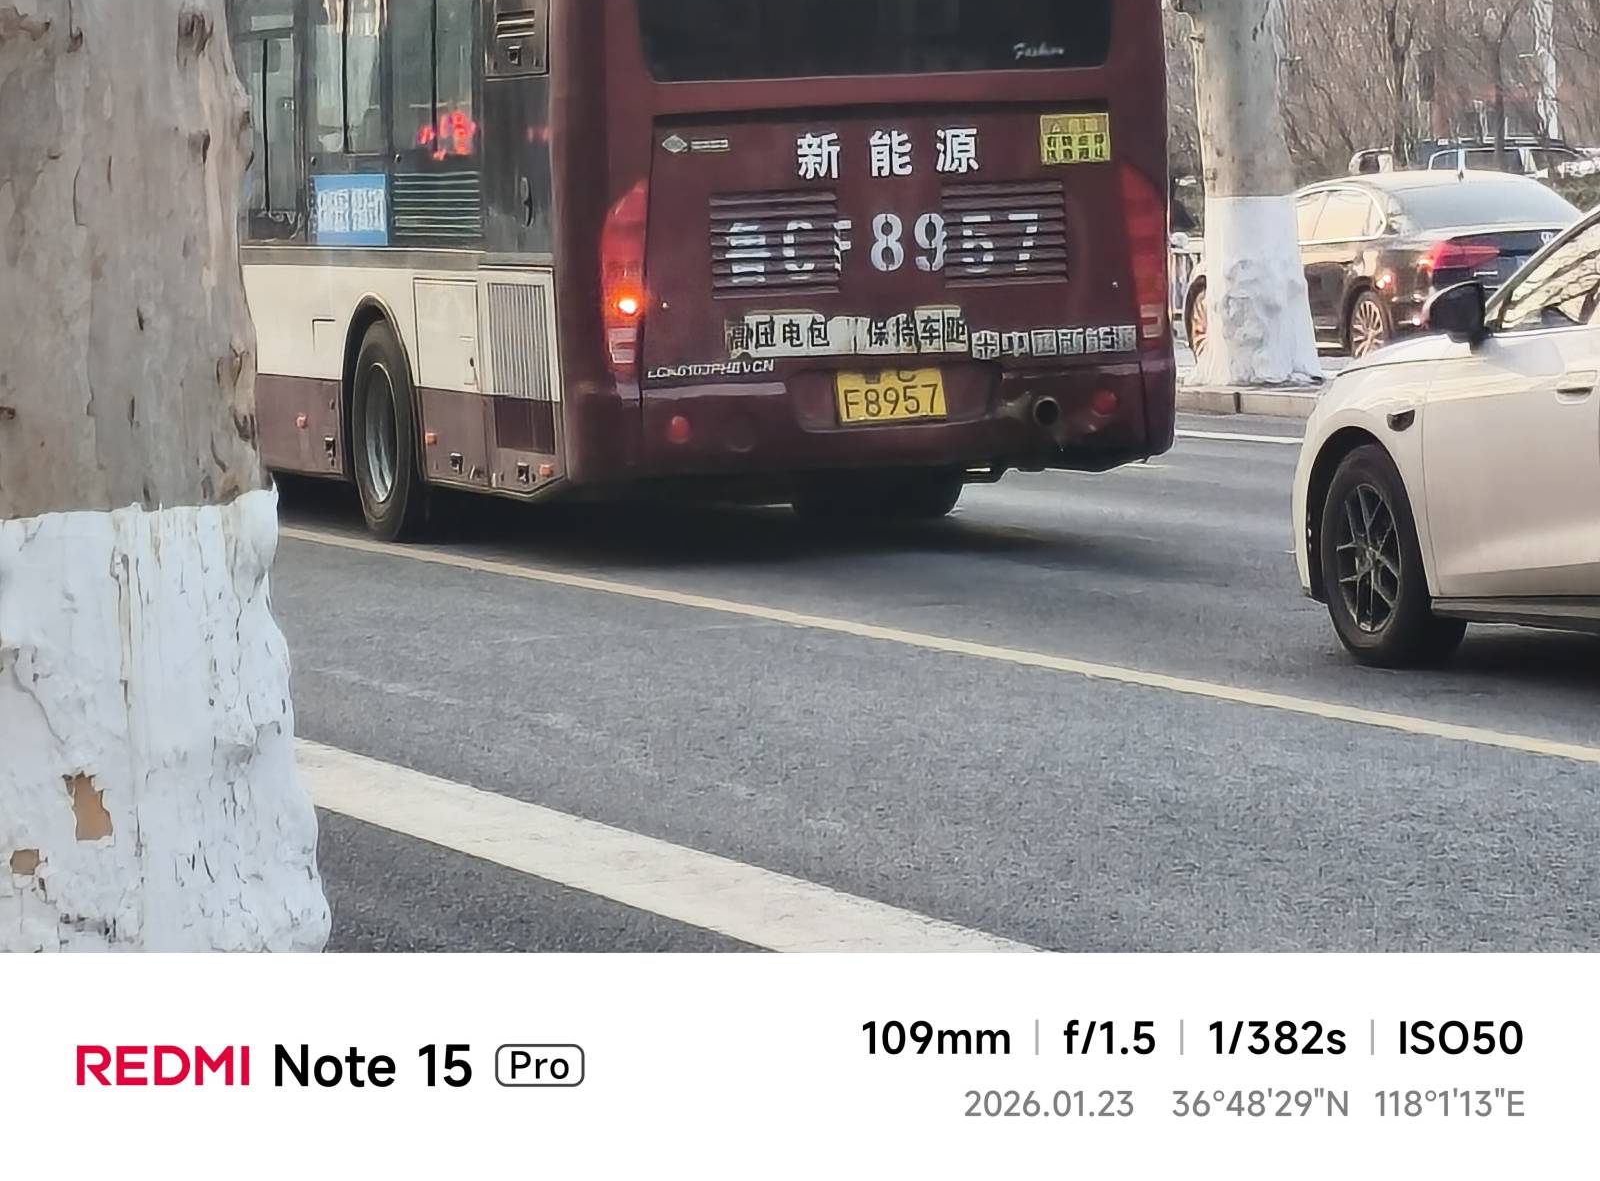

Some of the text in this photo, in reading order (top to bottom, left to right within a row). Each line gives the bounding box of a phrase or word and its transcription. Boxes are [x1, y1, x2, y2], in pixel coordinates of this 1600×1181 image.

[797, 127, 979, 180] 新能源
[844, 383, 939, 419] F8957
